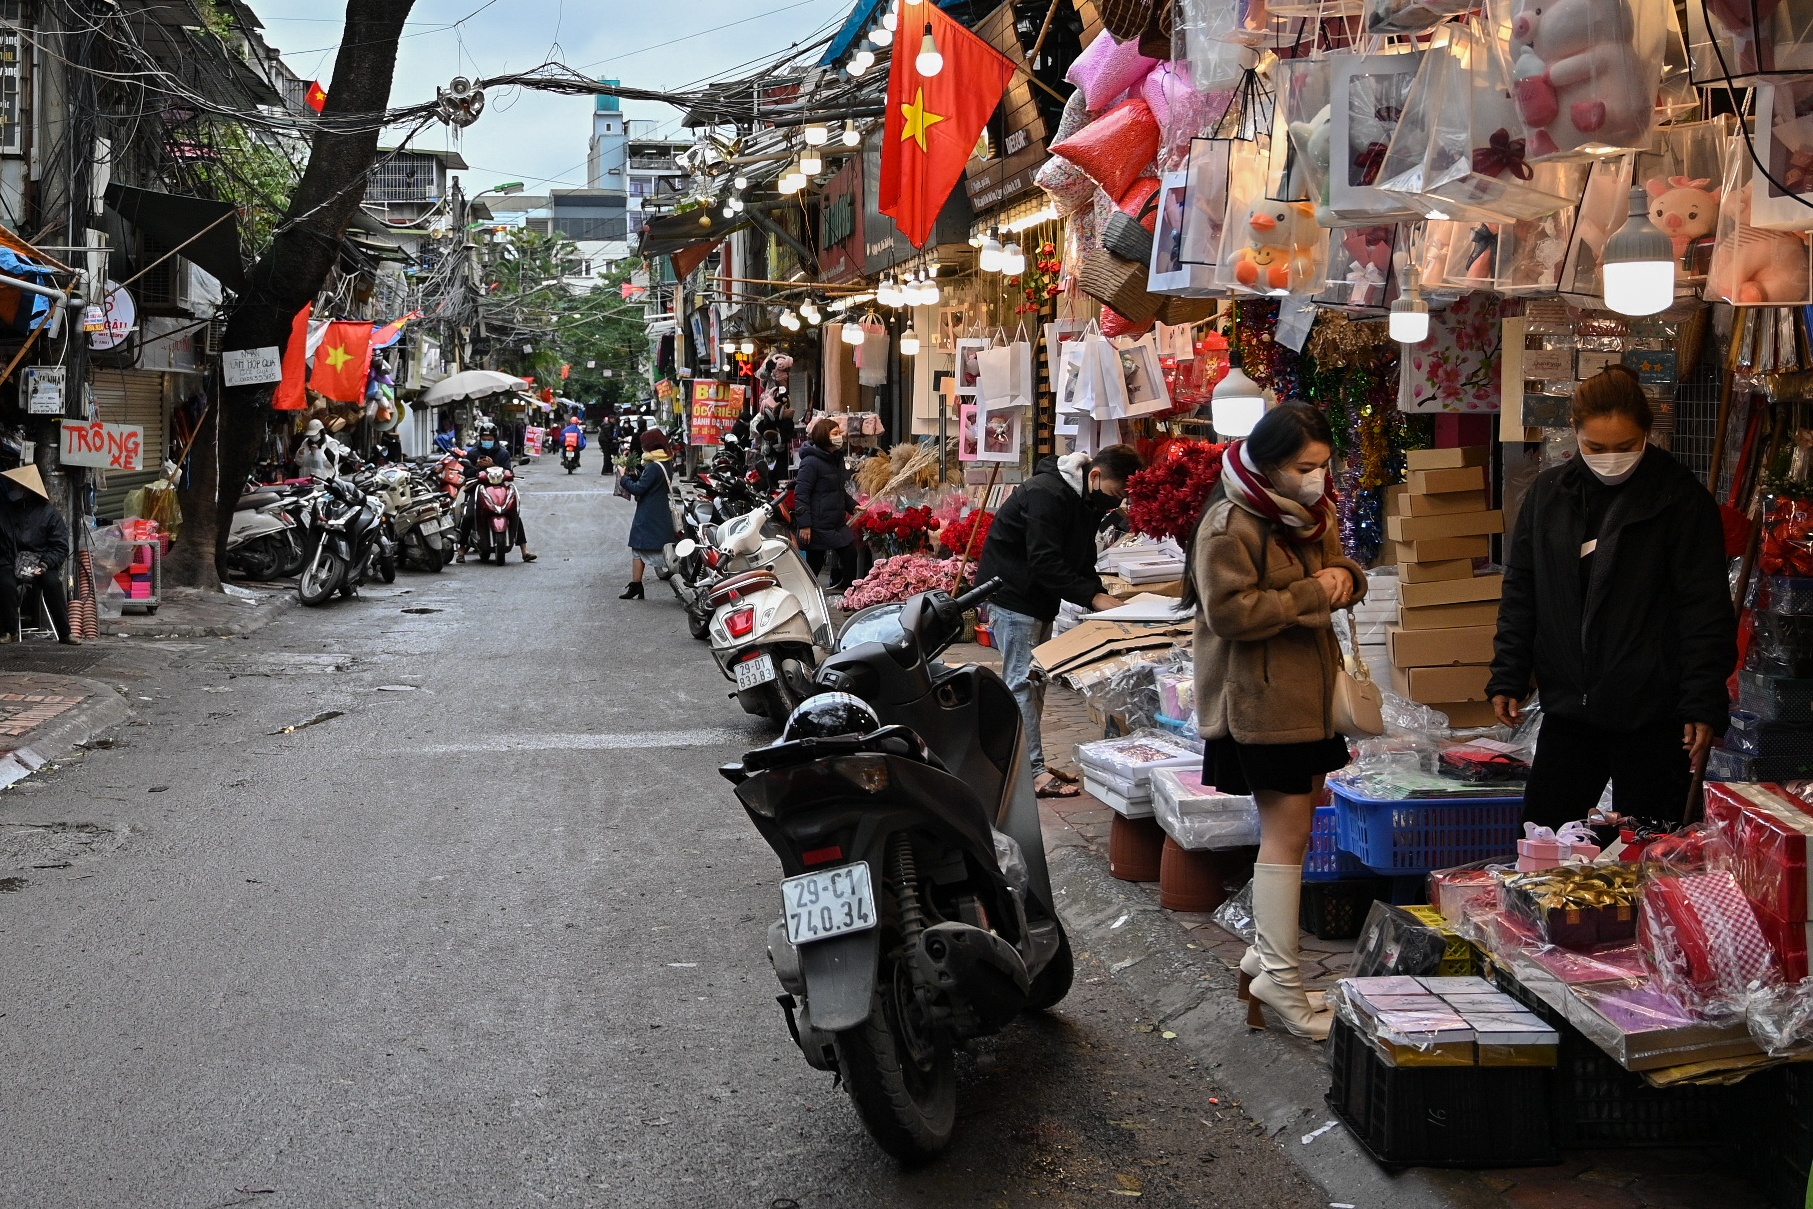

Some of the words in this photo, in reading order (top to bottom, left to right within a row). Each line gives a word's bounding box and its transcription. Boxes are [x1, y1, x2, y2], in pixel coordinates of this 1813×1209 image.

[110, 453, 136, 470] XE
[740, 668, 772, 688] 833.83
[794, 869, 856, 908] 29-C1
[790, 897, 869, 940] 740.34
